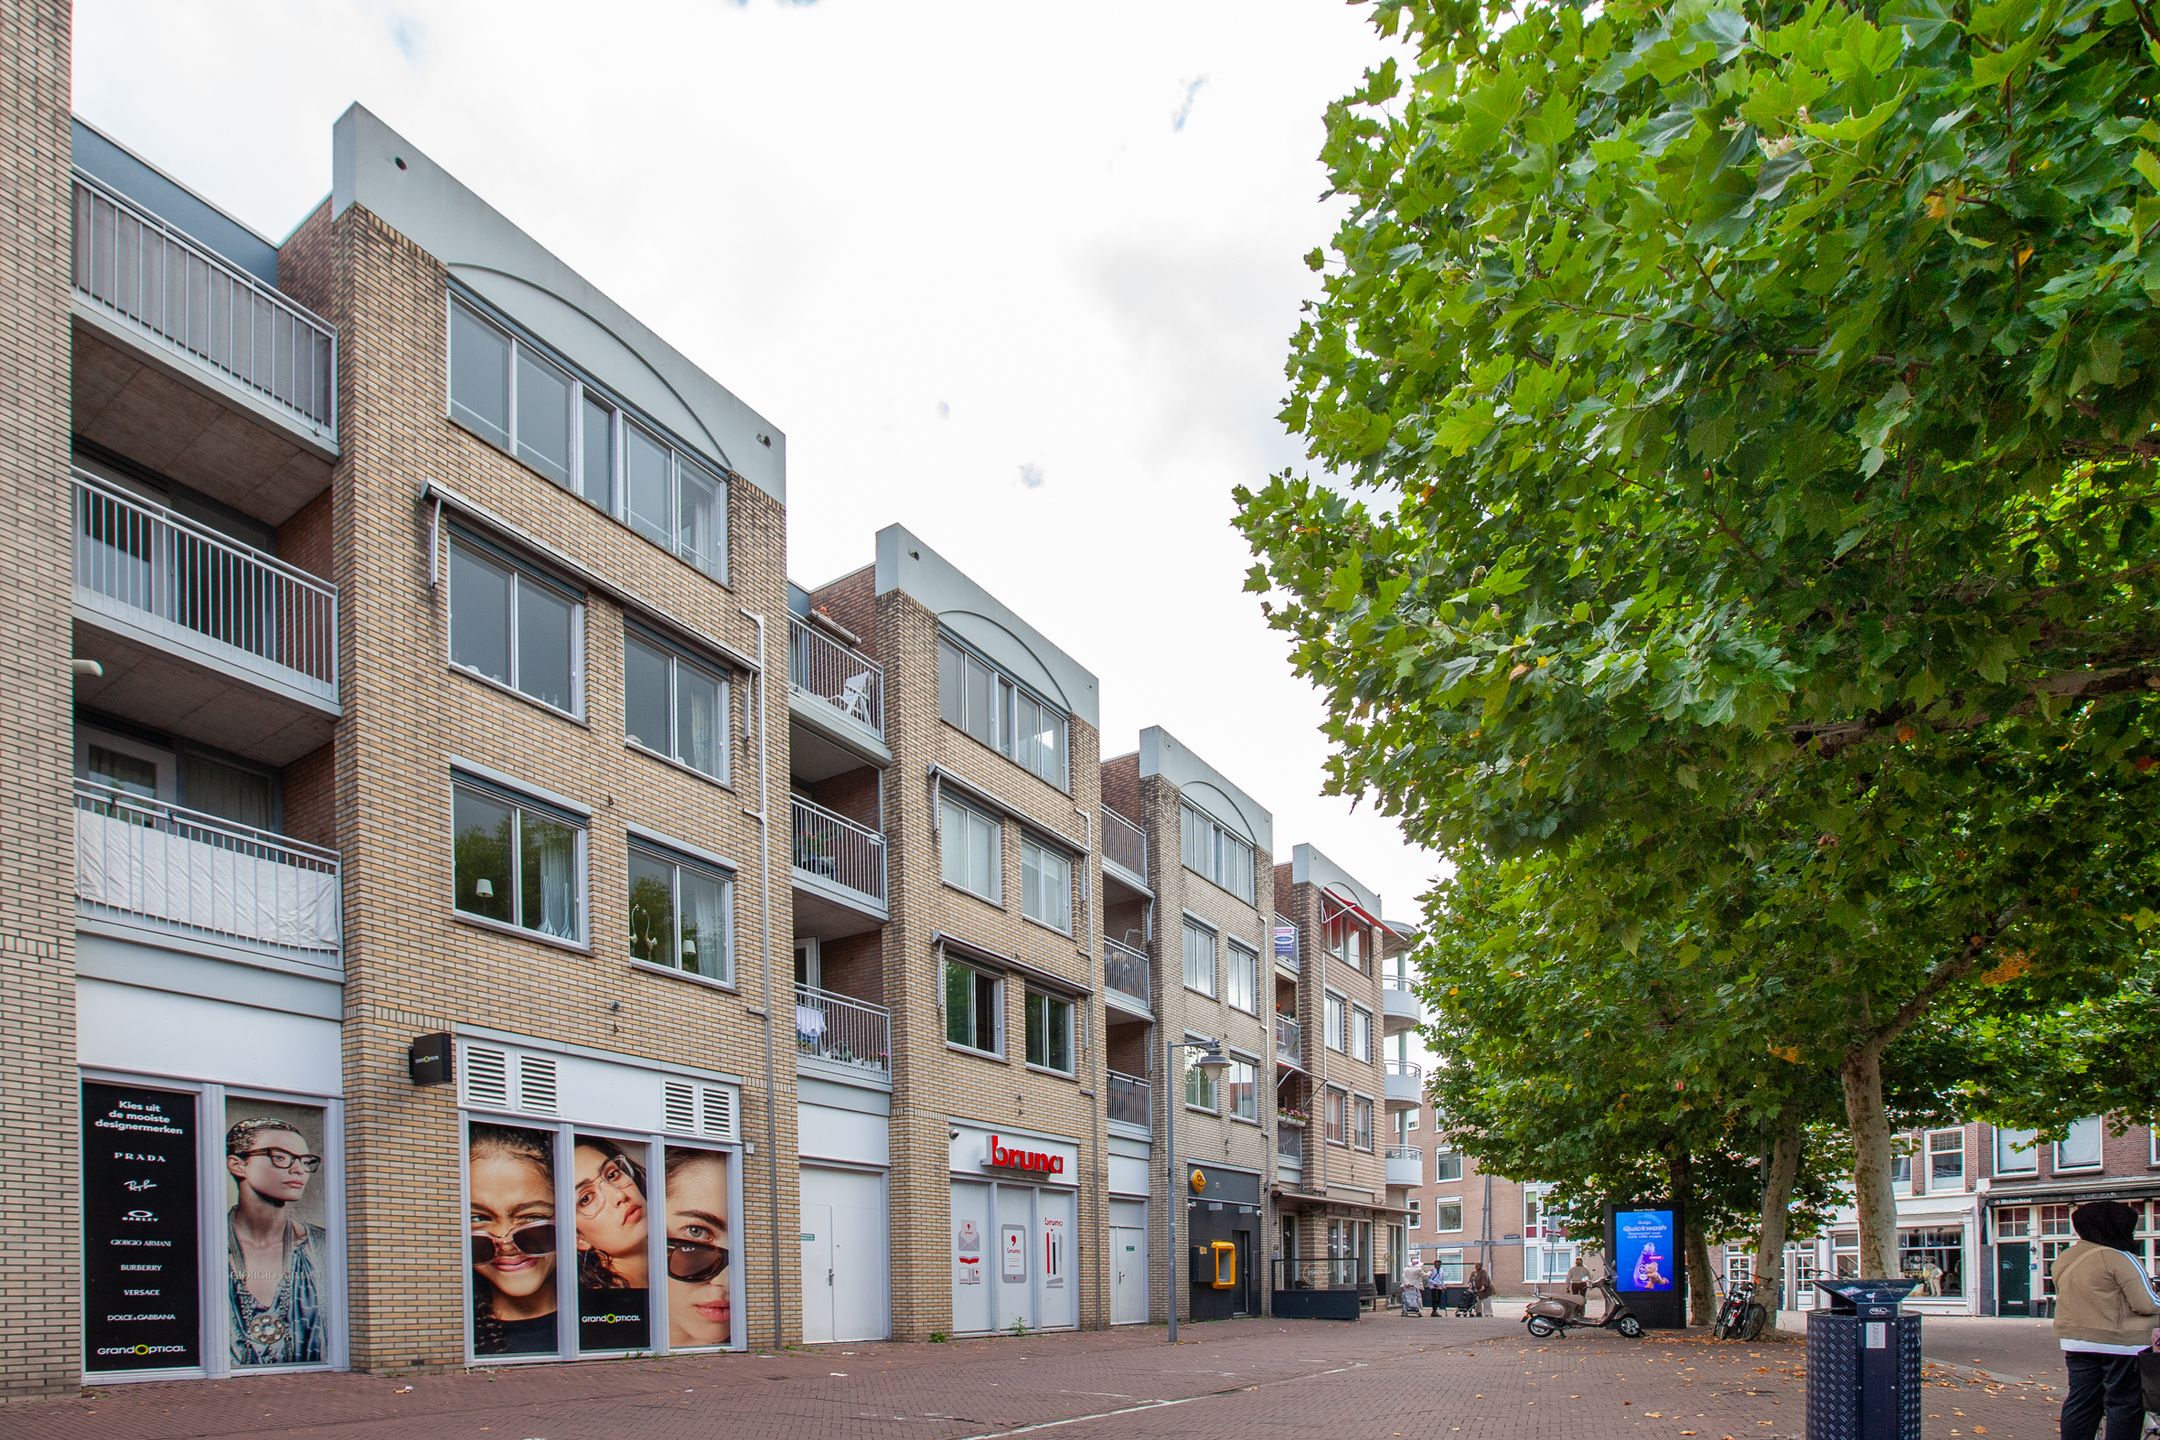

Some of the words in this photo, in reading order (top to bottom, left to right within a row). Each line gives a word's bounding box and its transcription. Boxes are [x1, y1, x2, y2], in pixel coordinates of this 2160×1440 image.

[119, 1100, 143, 1110] Kies
[145, 1103, 161, 1113] uit
[109, 1110, 124, 1119] de
[126, 1113, 171, 1124] mooiste
[95, 1119, 184, 1135] designermerken
[113, 1152, 167, 1163] PRADA
[992, 1135, 1064, 1174] bruna
[1044, 1217, 1063, 1227] bruna
